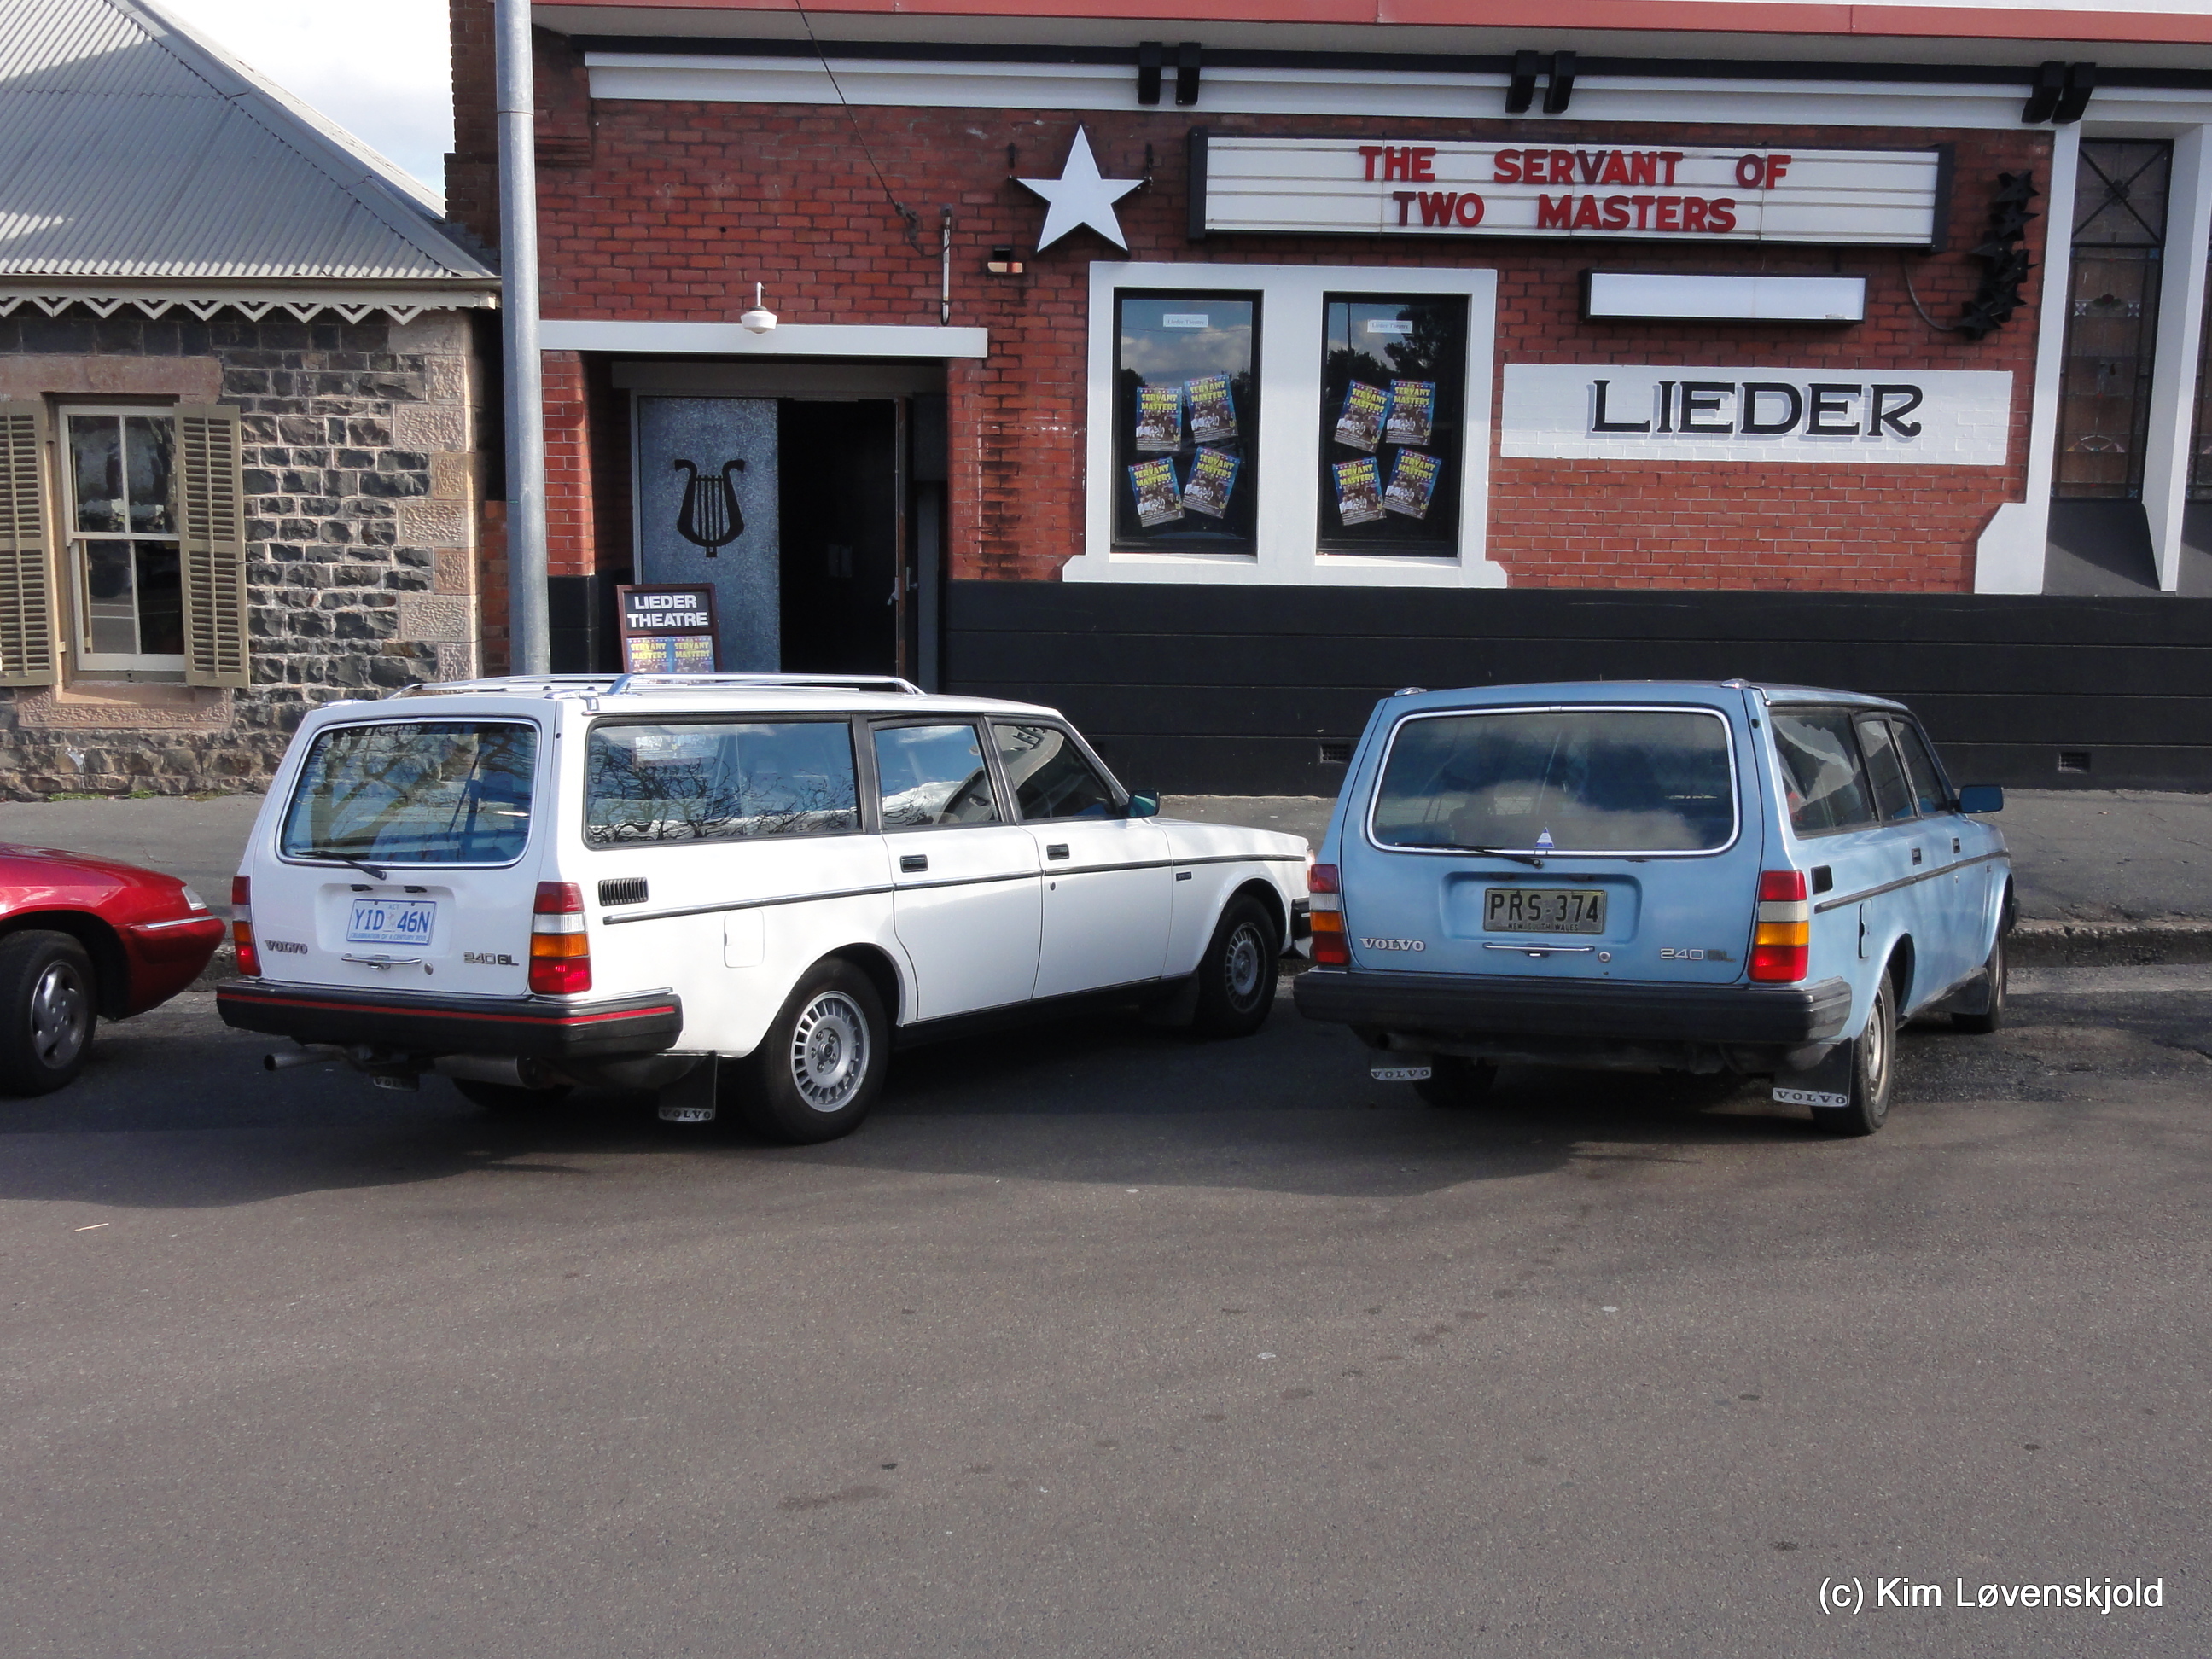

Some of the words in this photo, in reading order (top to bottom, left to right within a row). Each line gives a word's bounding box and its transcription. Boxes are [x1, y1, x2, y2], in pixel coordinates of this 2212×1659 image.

[1358, 145, 1436, 183] THE
[1493, 148, 1684, 187] SERVANT
[1735, 154, 1792, 189] OF
[1392, 191, 1485, 228] TWO
[1537, 194, 1737, 234] MASTERS
[1189, 381, 1225, 393] SERVANT
[1394, 387, 1430, 396] SERVANT
[1141, 393, 1178, 402] SERVANT
[1191, 389, 1227, 402] MASTERS
[1352, 387, 1388, 405] SERVANT
[1394, 395, 1429, 405] MASTERS
[1141, 402, 1178, 410] MASTERS
[1349, 396, 1385, 413] MASTERS
[1589, 378, 1924, 439] LIEDER
[1199, 454, 1235, 470] SERVANT
[1400, 455, 1436, 471] SERVANT
[1134, 463, 1170, 479] SERVANT
[1196, 462, 1232, 478] MASTERS
[1338, 463, 1373, 478] SERVANT
[1398, 463, 1434, 480] MASTERS
[1136, 472, 1172, 487] MASTERS
[1339, 472, 1375, 486] MASTERS
[634, 595, 697, 610] LIEDER
[627, 612, 709, 627] THEATRE
[631, 643, 667, 651] SERVANT
[675, 649, 710, 658] MASTERS
[632, 651, 667, 660] MASTERS
[355, 908, 385, 930] YID
[397, 911, 431, 933] 46N
[264, 940, 308, 954] VOLVO
[1359, 937, 1425, 952] VOLVO
[1371, 1069, 1429, 1078] VOLVO
[1776, 1091, 1846, 1103] VOLVO
[662, 1109, 712, 1119] VOLVO
